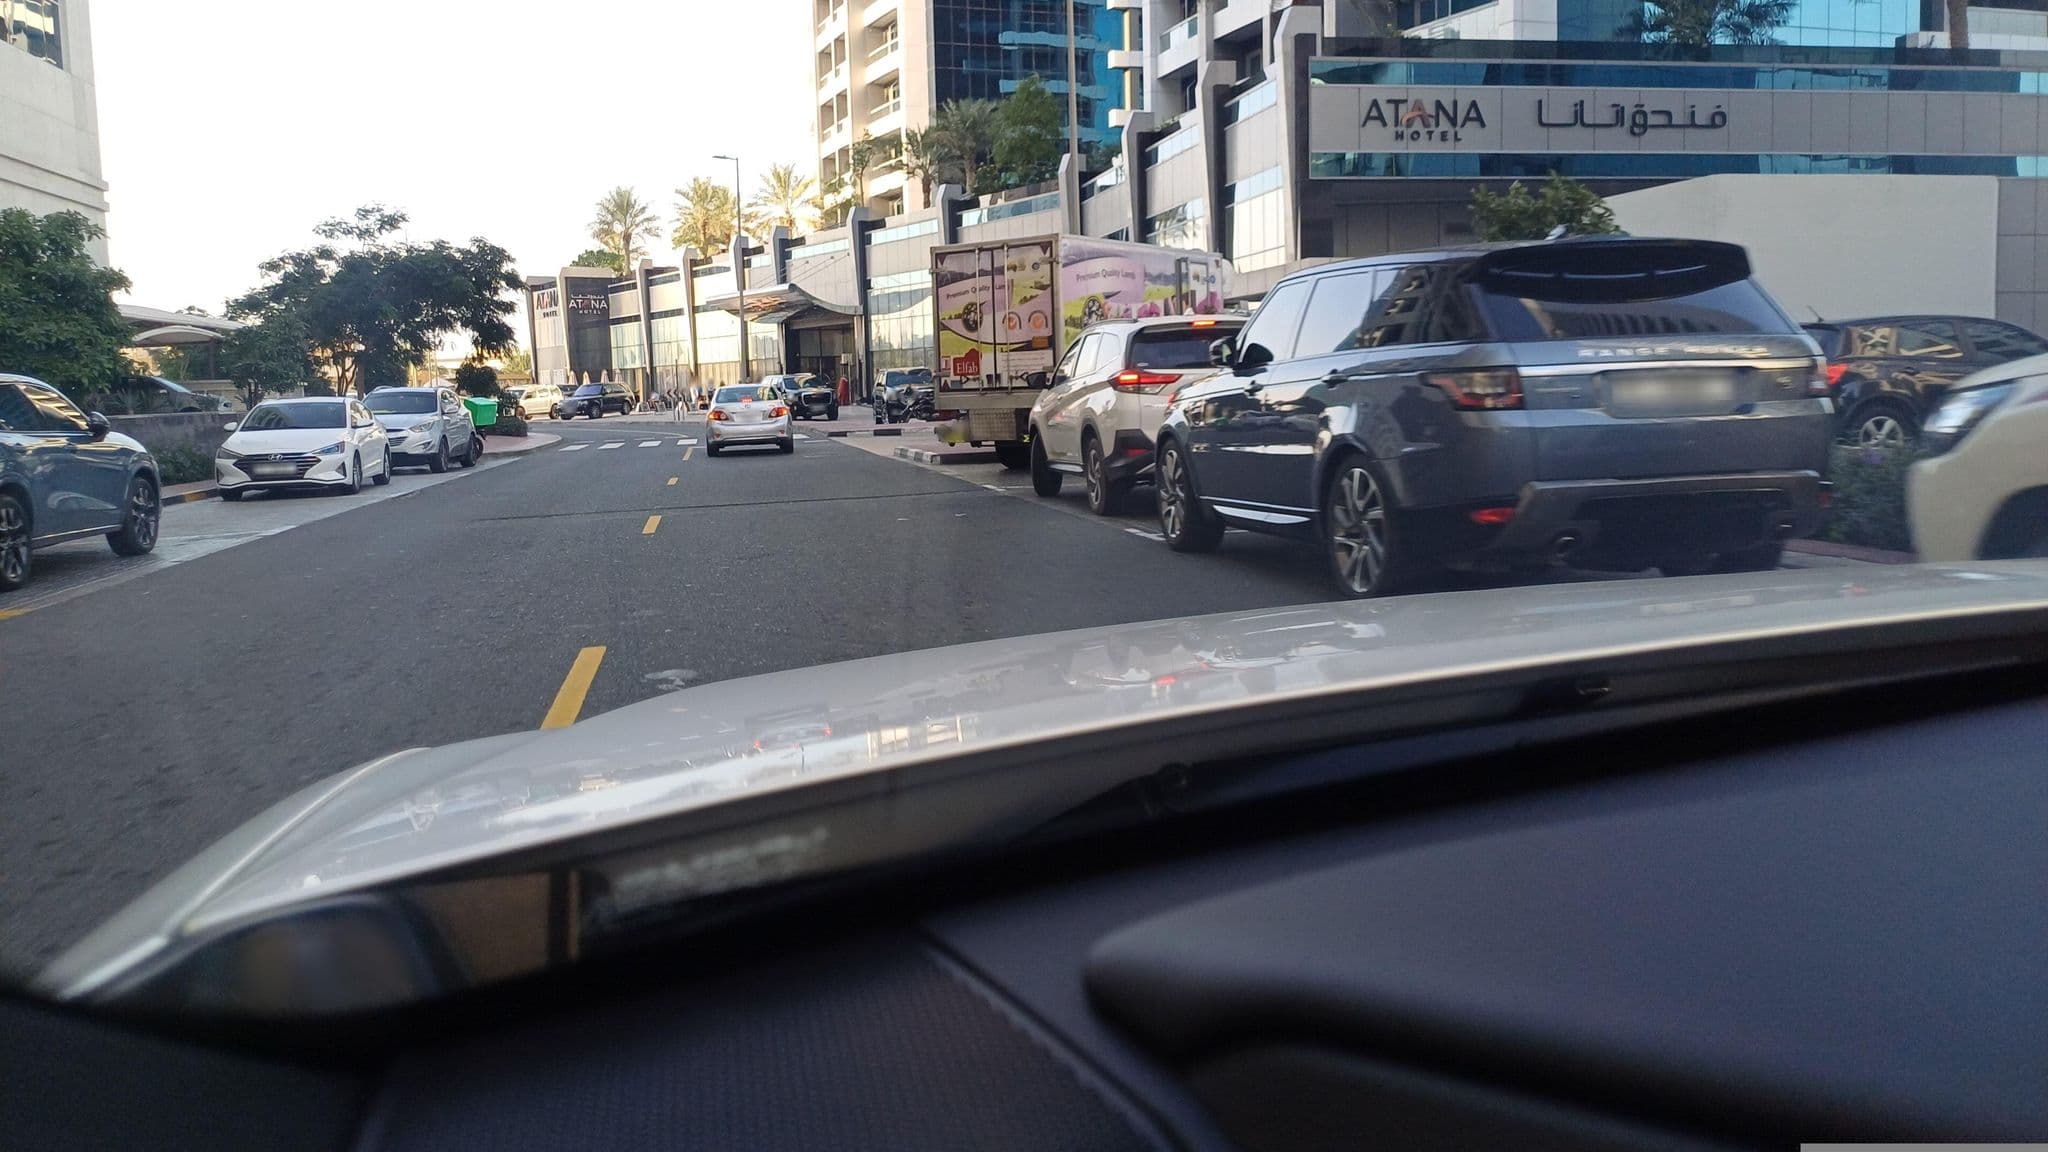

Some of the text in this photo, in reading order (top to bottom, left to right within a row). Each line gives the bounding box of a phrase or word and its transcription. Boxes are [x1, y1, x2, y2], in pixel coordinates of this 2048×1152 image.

[1361, 98, 1487, 128] ATANA
[1629, 104, 1727, 137] فندق
[1394, 130, 1462, 142] HOTEL
[568, 299, 608, 309] ATANA
[1578, 347, 1670, 357] RANGE
